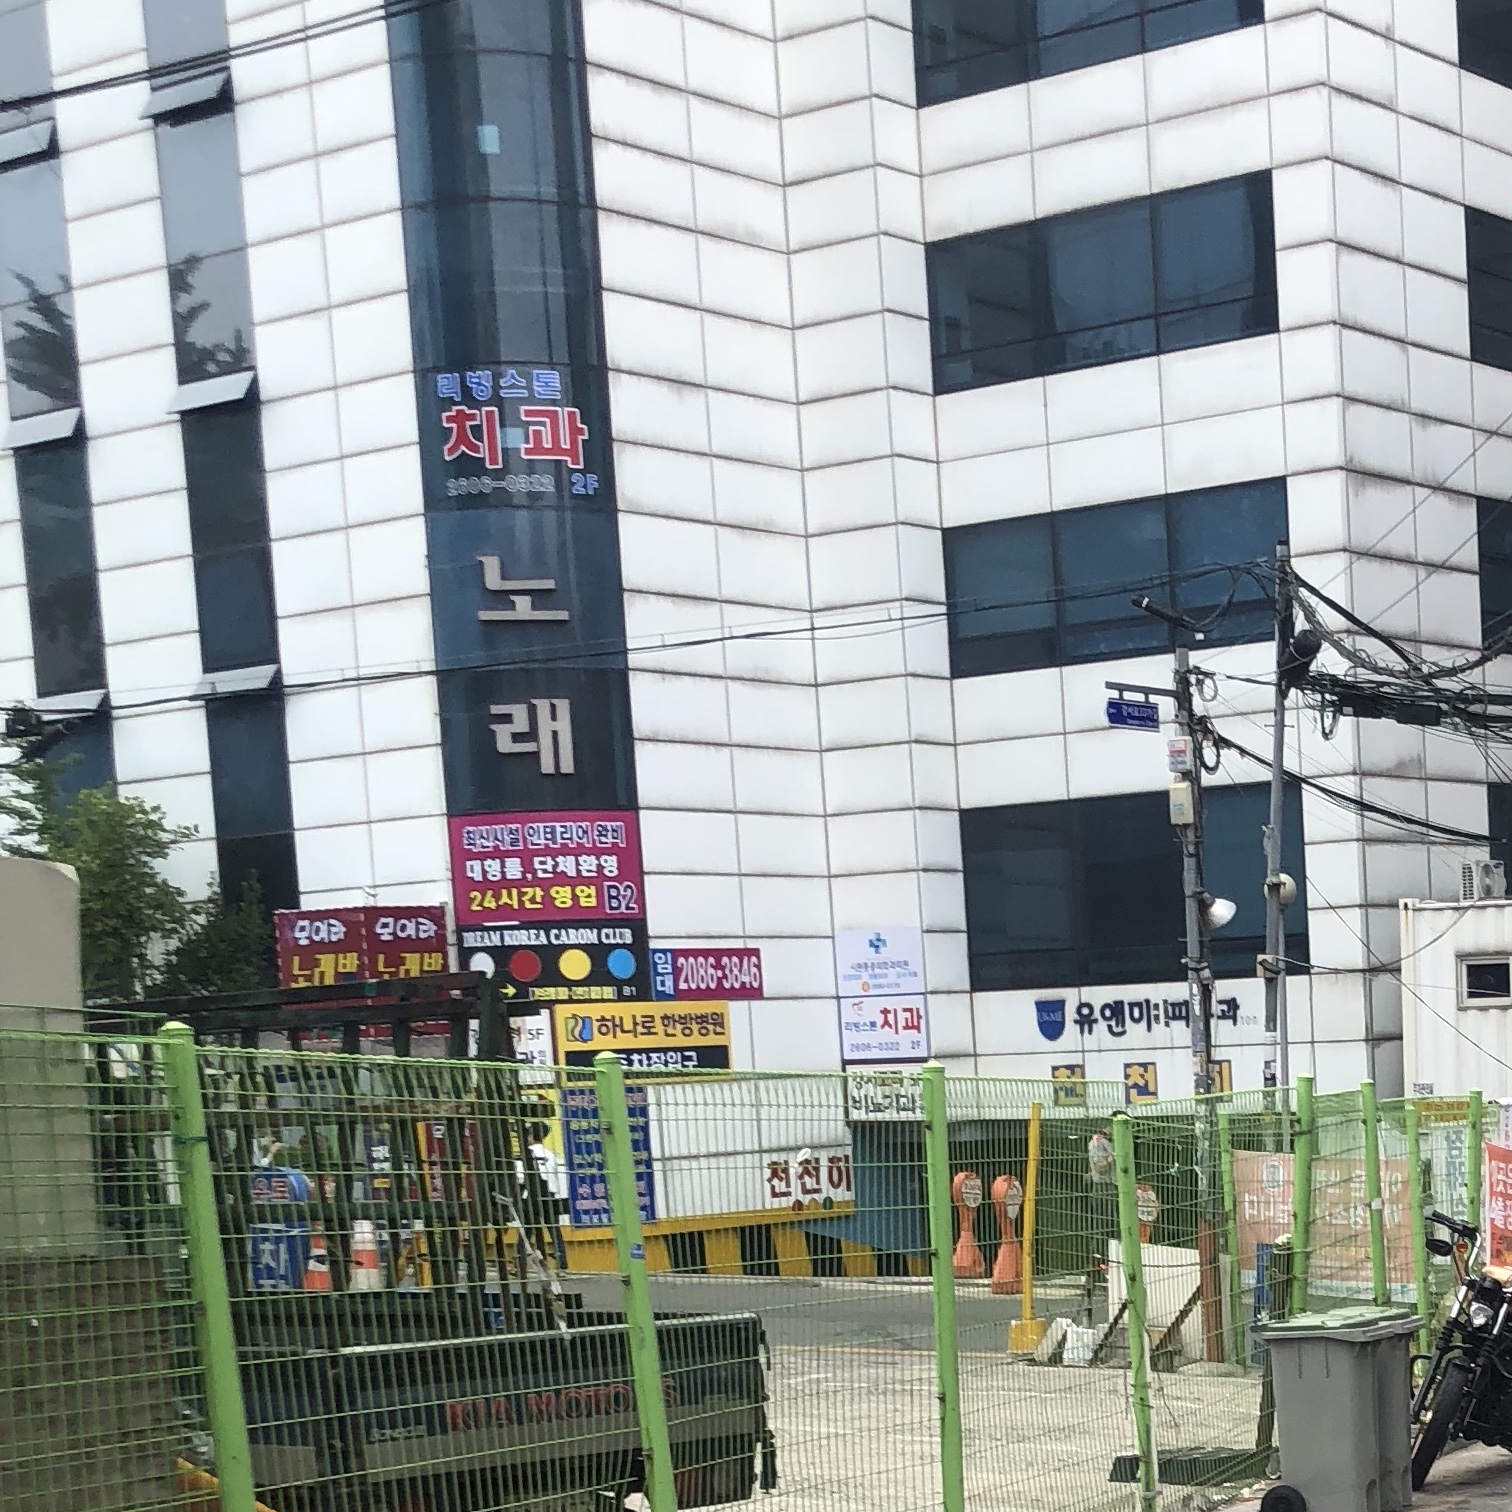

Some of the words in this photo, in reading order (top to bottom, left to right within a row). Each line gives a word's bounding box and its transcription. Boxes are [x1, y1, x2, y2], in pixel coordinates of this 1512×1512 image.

[436, 369, 561, 401] 리빙스톤
[442, 405, 589, 469] 치과
[570, 473, 599, 495] 2F
[526, 822, 592, 848] 인테리어
[469, 887, 544, 911] 24시간
[550, 885, 597, 908] 영업
[603, 882, 638, 913] B2
[294, 919, 346, 945] 모여라
[376, 917, 437, 940] 모여라
[503, 929, 548, 946] KOREA
[550, 928, 599, 945] CAROM
[601, 928, 633, 944] CLUB
[654, 952, 674, 995] 임대
[677, 955, 760, 991] 2086-3846
[595, 1015, 658, 1039] 하나로
[660, 1012, 726, 1038] 한방병원
[880, 1007, 922, 1035] 치과
[621, 1051, 698, 1069] 차장입구
